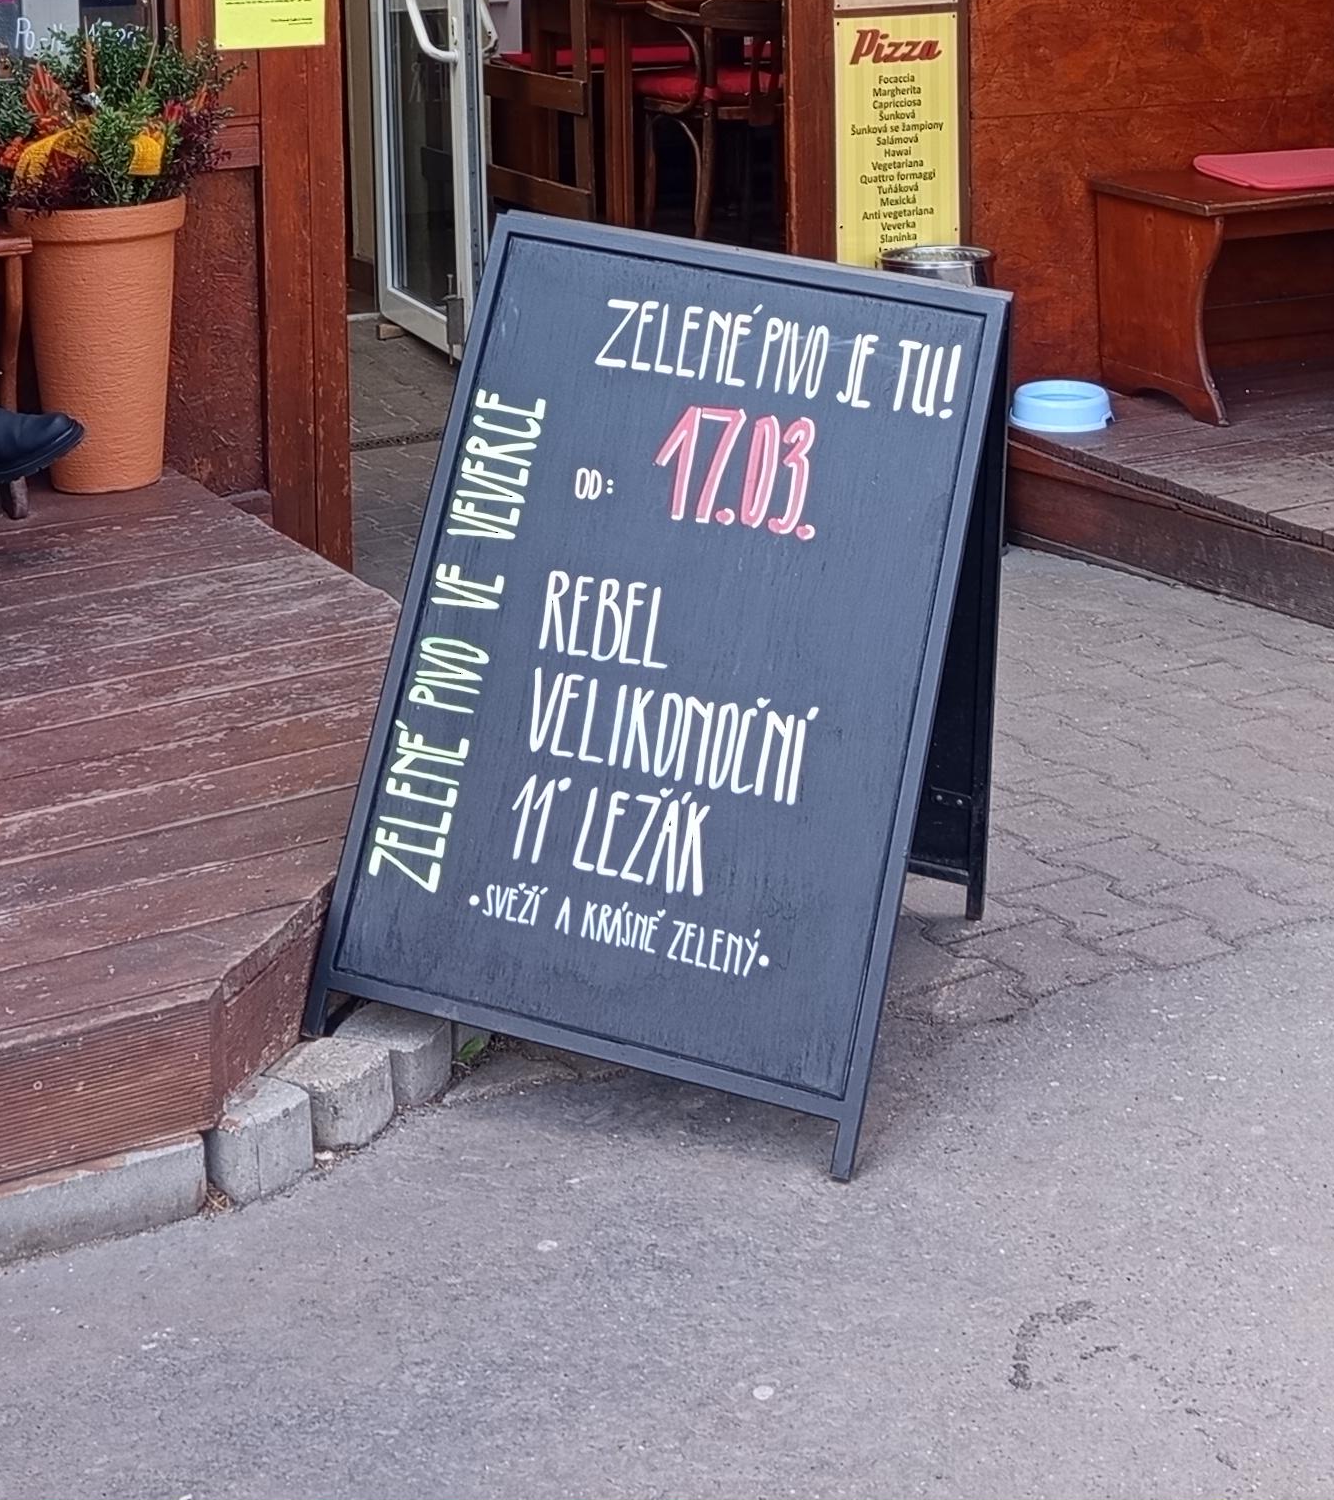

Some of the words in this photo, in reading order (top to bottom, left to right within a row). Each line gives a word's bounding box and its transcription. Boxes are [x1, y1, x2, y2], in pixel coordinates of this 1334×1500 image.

[849, 29, 942, 65] Pizza
[878, 73, 915, 84] Focaccia
[872, 86, 922, 98] Margherita
[872, 98, 922, 110] Capricciosa
[879, 109, 916, 121] Šunková
[851, 123, 888, 136] Šunková
[890, 124, 900, 132] se
[901, 120, 944, 133] žampiony
[876, 135, 919, 146] Salámová
[884, 147, 912, 157] Hawai
[871, 159, 924, 171] Vegetariana
[860, 172, 895, 184] Quattro
[897, 168, 936, 182] formaggi
[877, 184, 919, 195] Tuňáková
[880, 195, 916, 207] Mexická
[861, 210, 881, 220] Anti
[882, 206, 934, 220] vegetariana
[881, 220, 916, 231] Veverka
[880, 231, 917, 243] Slaninka
[595, 298, 763, 388] ZELENÉ
[754, 316, 826, 399] PIVO
[836, 333, 879, 410] JE
[892, 338, 962, 420] TU!
[447, 388, 546, 541] VEVERCE
[652, 404, 817, 540] 17.03.
[574, 467, 615, 500] OD:
[431, 562, 505, 610] VE
[538, 569, 668, 670] REBEL
[408, 635, 490, 714] PIVO
[529, 667, 819, 805] VELIKONOČNÍ
[368, 718, 470, 893] ZELENÉ
[572, 788, 711, 896] LEŽÁK
[482, 882, 549, 926] SVĚŽÍ
[554, 895, 570, 935] A
[580, 900, 667, 954] KRÁSNĚ
[667, 928, 762, 977] ZELENÝ
